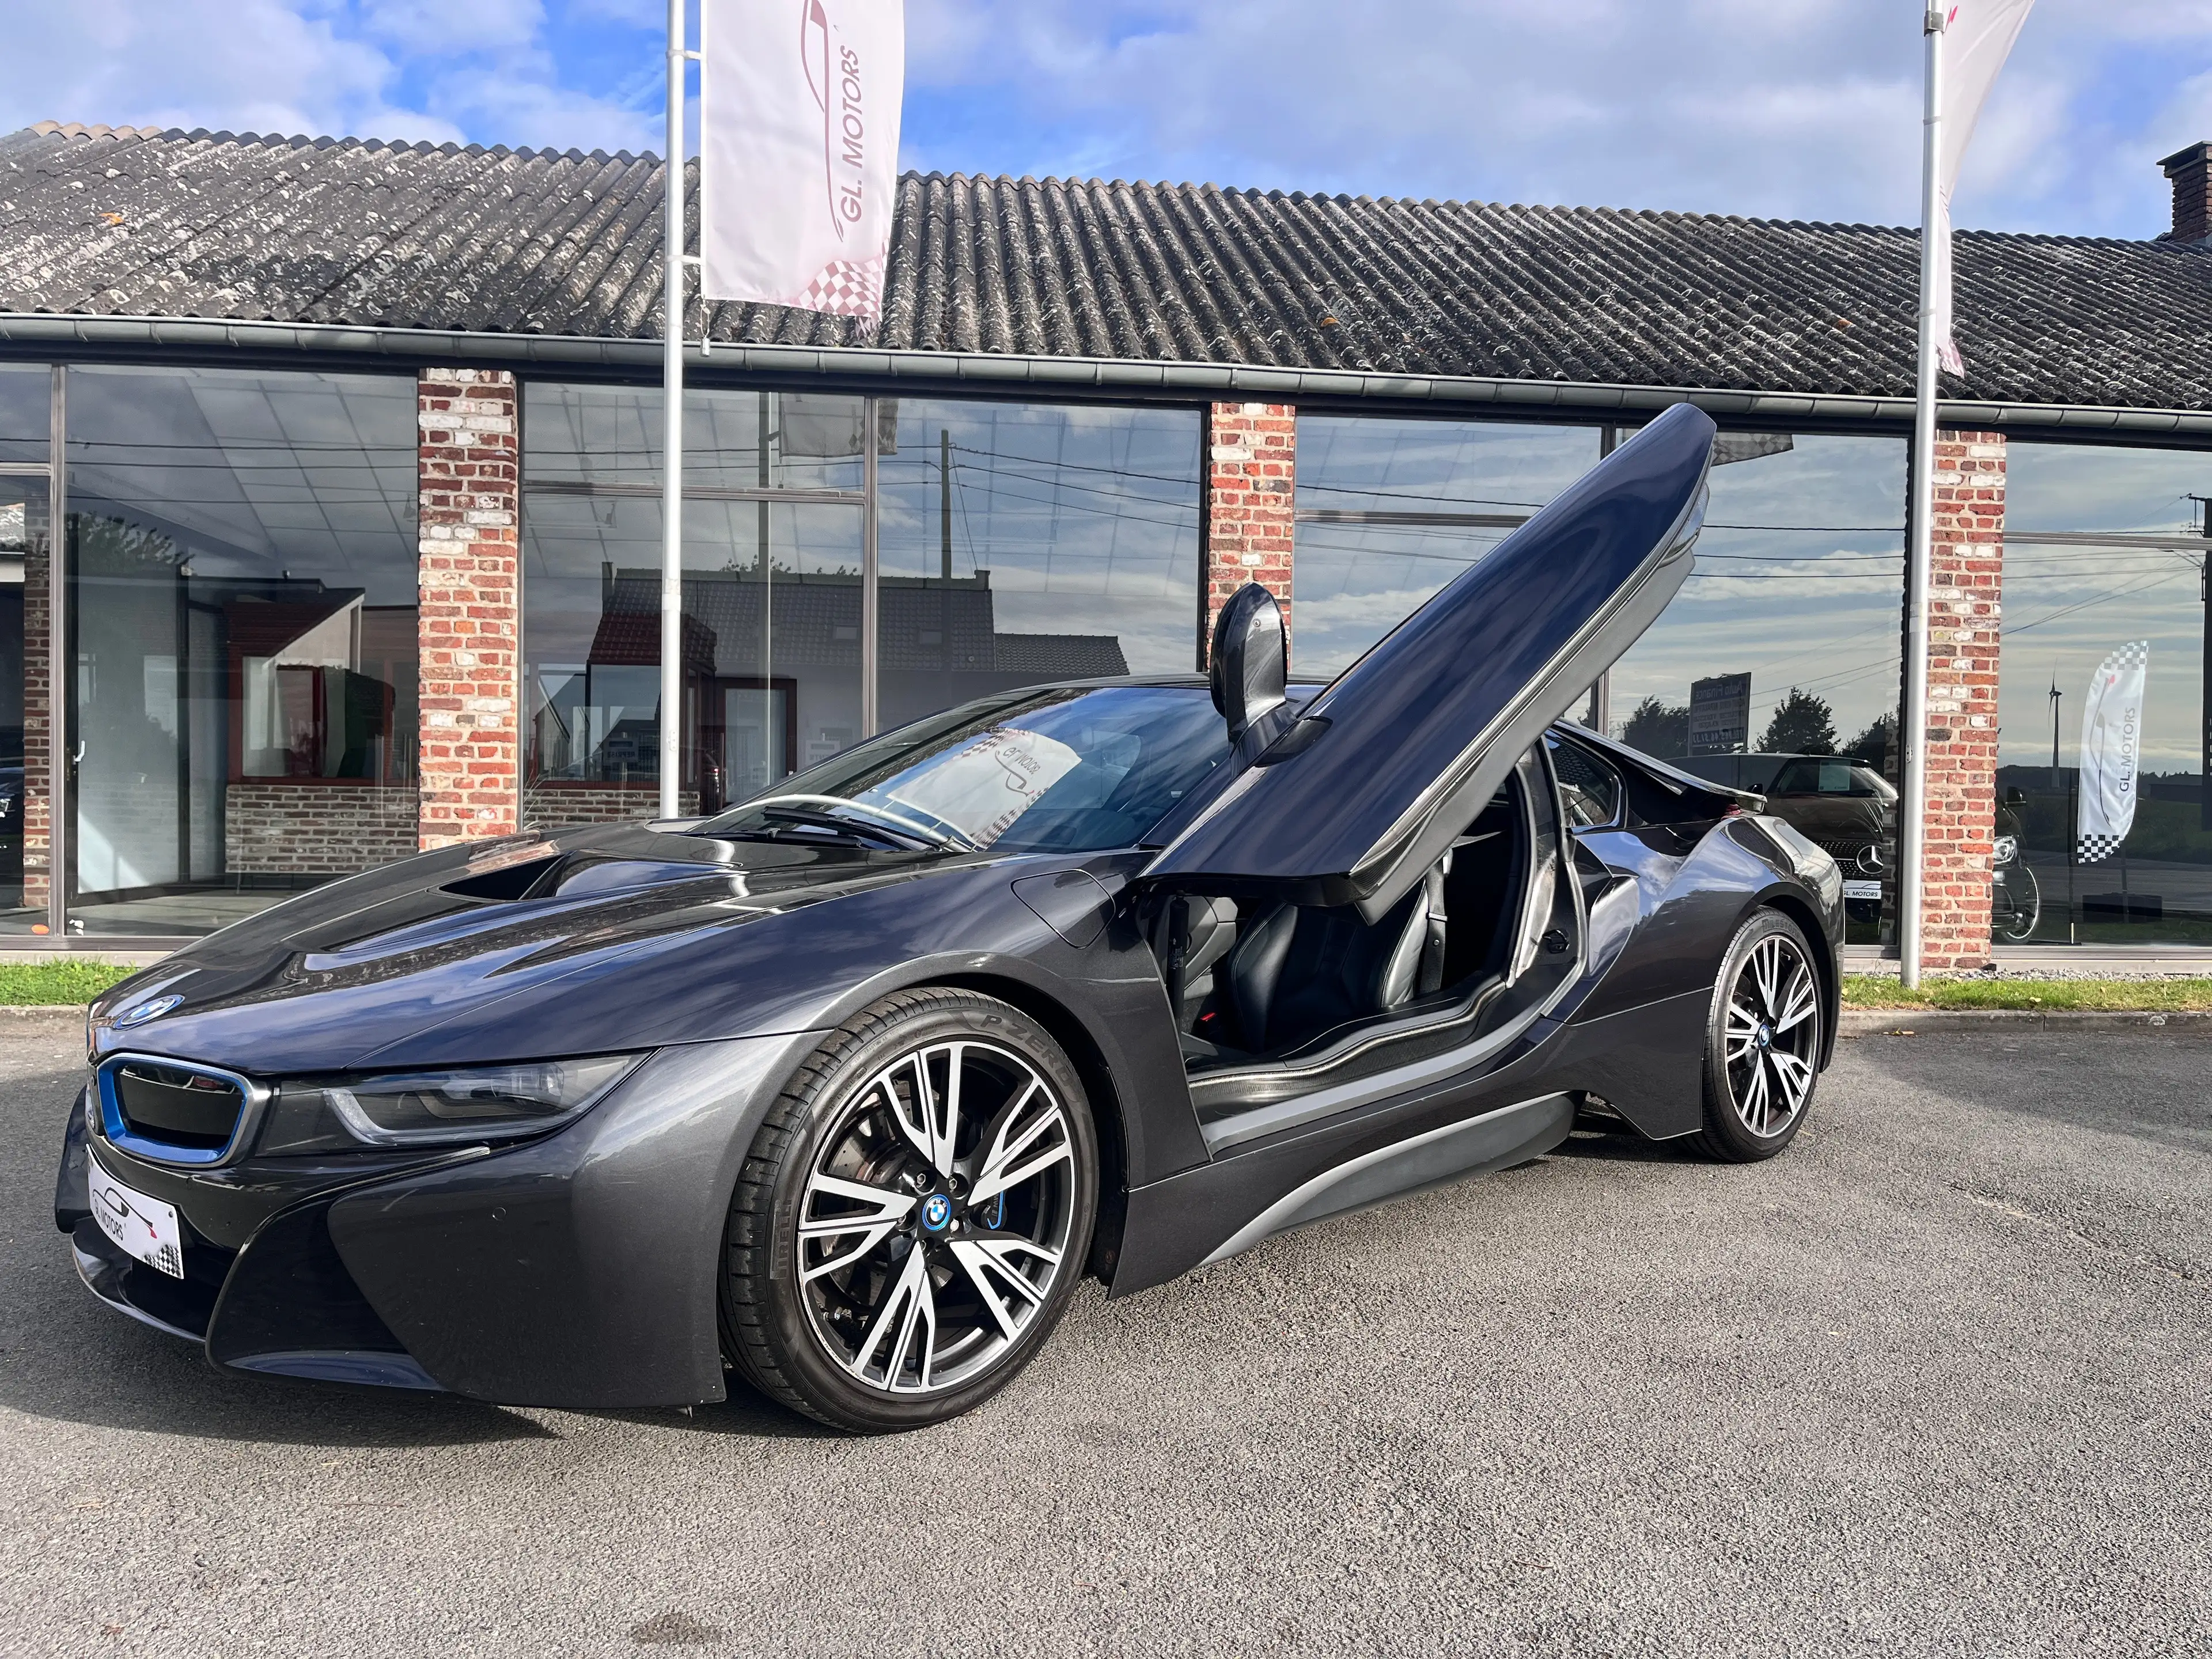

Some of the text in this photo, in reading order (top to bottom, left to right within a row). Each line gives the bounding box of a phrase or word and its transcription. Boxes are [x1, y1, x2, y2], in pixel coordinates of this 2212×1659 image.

[839, 45, 864, 169] MOTORS
[2121, 707, 2135, 767] MOTORS
[980, 1014, 1002, 1028] P
[101, 1209, 123, 1241] MOTORS
